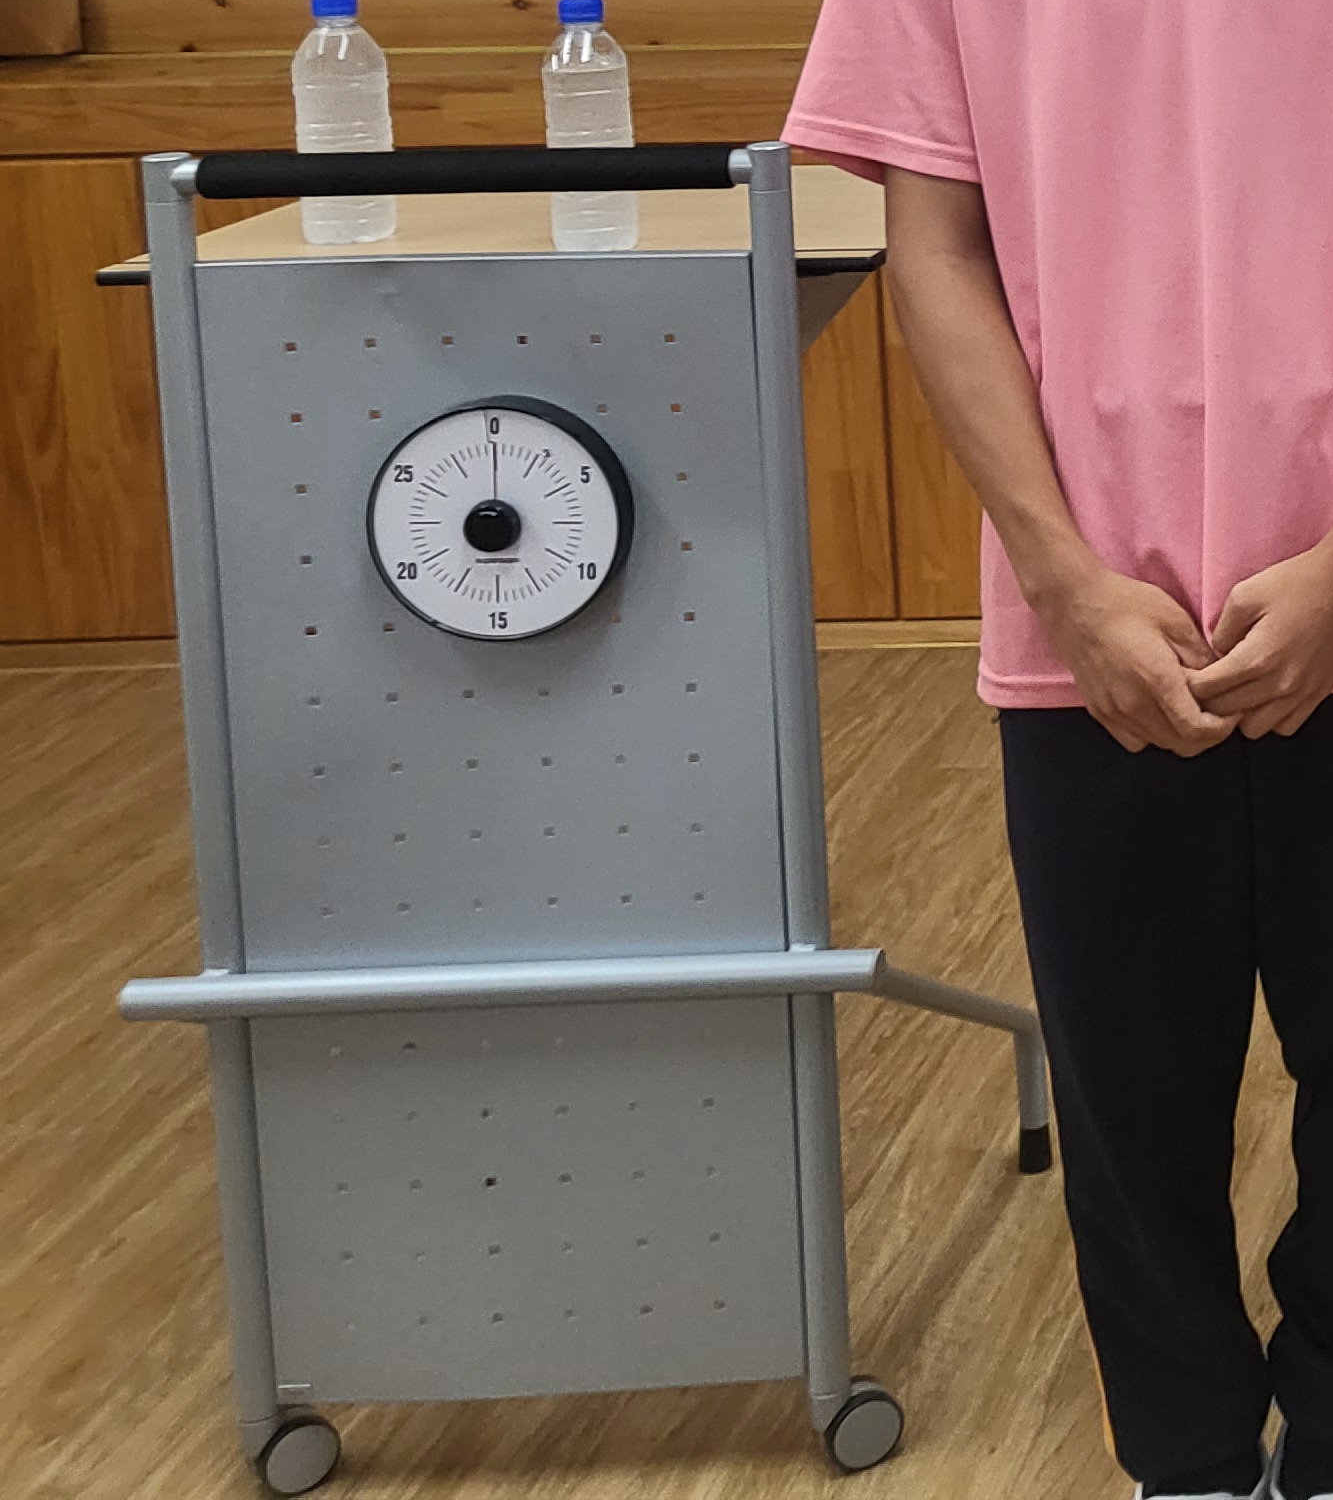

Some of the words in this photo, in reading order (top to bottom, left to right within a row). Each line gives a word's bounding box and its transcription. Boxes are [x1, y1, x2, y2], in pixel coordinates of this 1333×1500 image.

[489, 416, 500, 435] 0
[393, 464, 414, 484] 25
[580, 465, 591, 484] 5
[396, 561, 418, 580] 20
[577, 562, 597, 581] 10
[488, 611, 508, 630] 15
